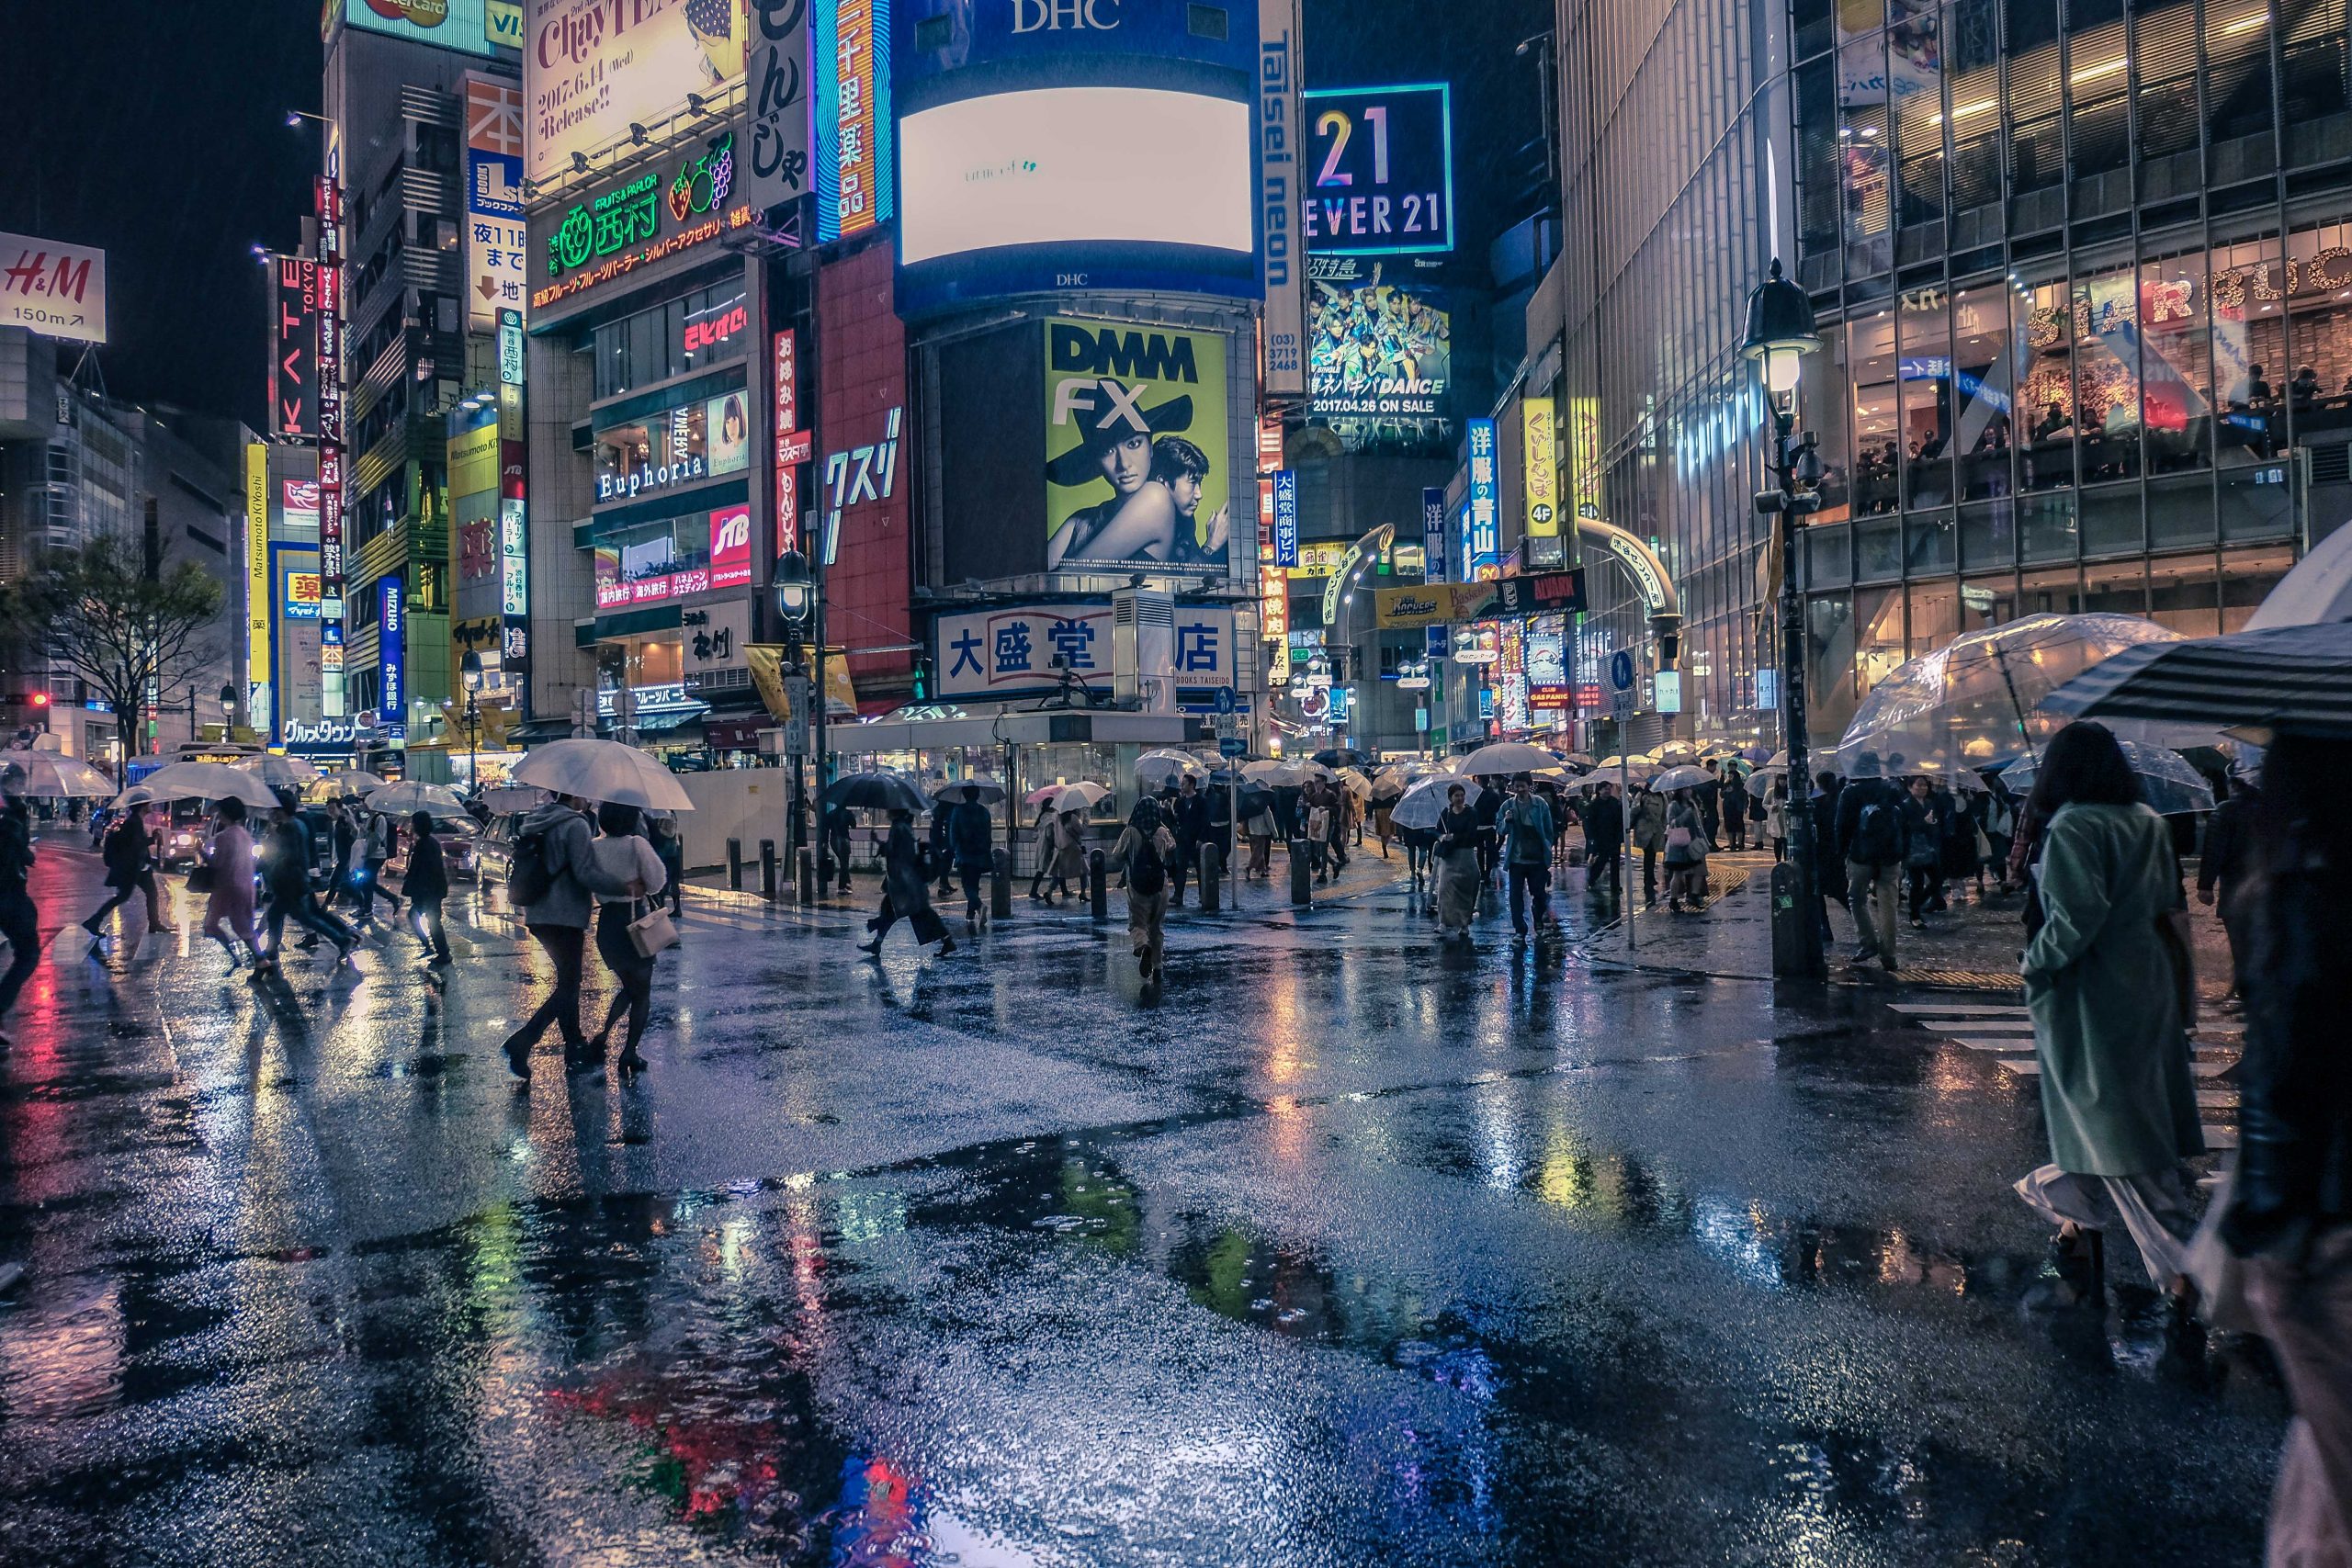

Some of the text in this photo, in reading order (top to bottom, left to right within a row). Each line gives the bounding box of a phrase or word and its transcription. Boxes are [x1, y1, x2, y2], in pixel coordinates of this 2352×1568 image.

[493, 13, 524, 38] VI
[1012, 0, 1120, 34] DHC
[1316, 107, 1389, 186] 21
[477, 164, 489, 196] BOOK
[1403, 192, 1438, 232] 21
[487, 248, 523, 269] まで
[5, 249, 91, 304] H&M
[303, 261, 314, 314] TOKYO
[1057, 274, 1088, 287] DHC
[13, 307, 65, 326] 150m
[1050, 323, 1199, 384] DMM
[1270, 347, 1297, 359] 3719
[1271, 333, 1295, 346] (03)
[1270, 359, 1297, 371] 2468
[1053, 378, 1152, 433] FX
[1314, 399, 1435, 412] 2017.04.26 ON SALE
[450, 442, 487, 461] Matsumoto
[504, 465, 522, 476] JTB
[600, 456, 703, 498] Euphoria
[1471, 426, 1495, 554] 洋服の青山
[1278, 476, 1294, 563] 大盛堂商事ビル
[1532, 506, 1551, 521] 4F
[254, 517, 264, 579] Matsumoto
[714, 513, 749, 556] JTB
[675, 571, 707, 584] ハネムーン
[1612, 538, 1661, 605] 渋谷センター街
[601, 588, 631, 604] 国内旅行
[636, 581, 668, 599] 海外旅行
[387, 588, 398, 632] MIZUHO
[1391, 598, 1438, 615] ROCKERS
[949, 618, 1218, 679] 大盛堂店
[386, 663, 398, 711] みずほ銀行
[1176, 676, 1230, 684] BOOKS TAISEIDO
[1504, 676, 1516, 721] ラーメン
[284, 717, 356, 743] グルメタウン
